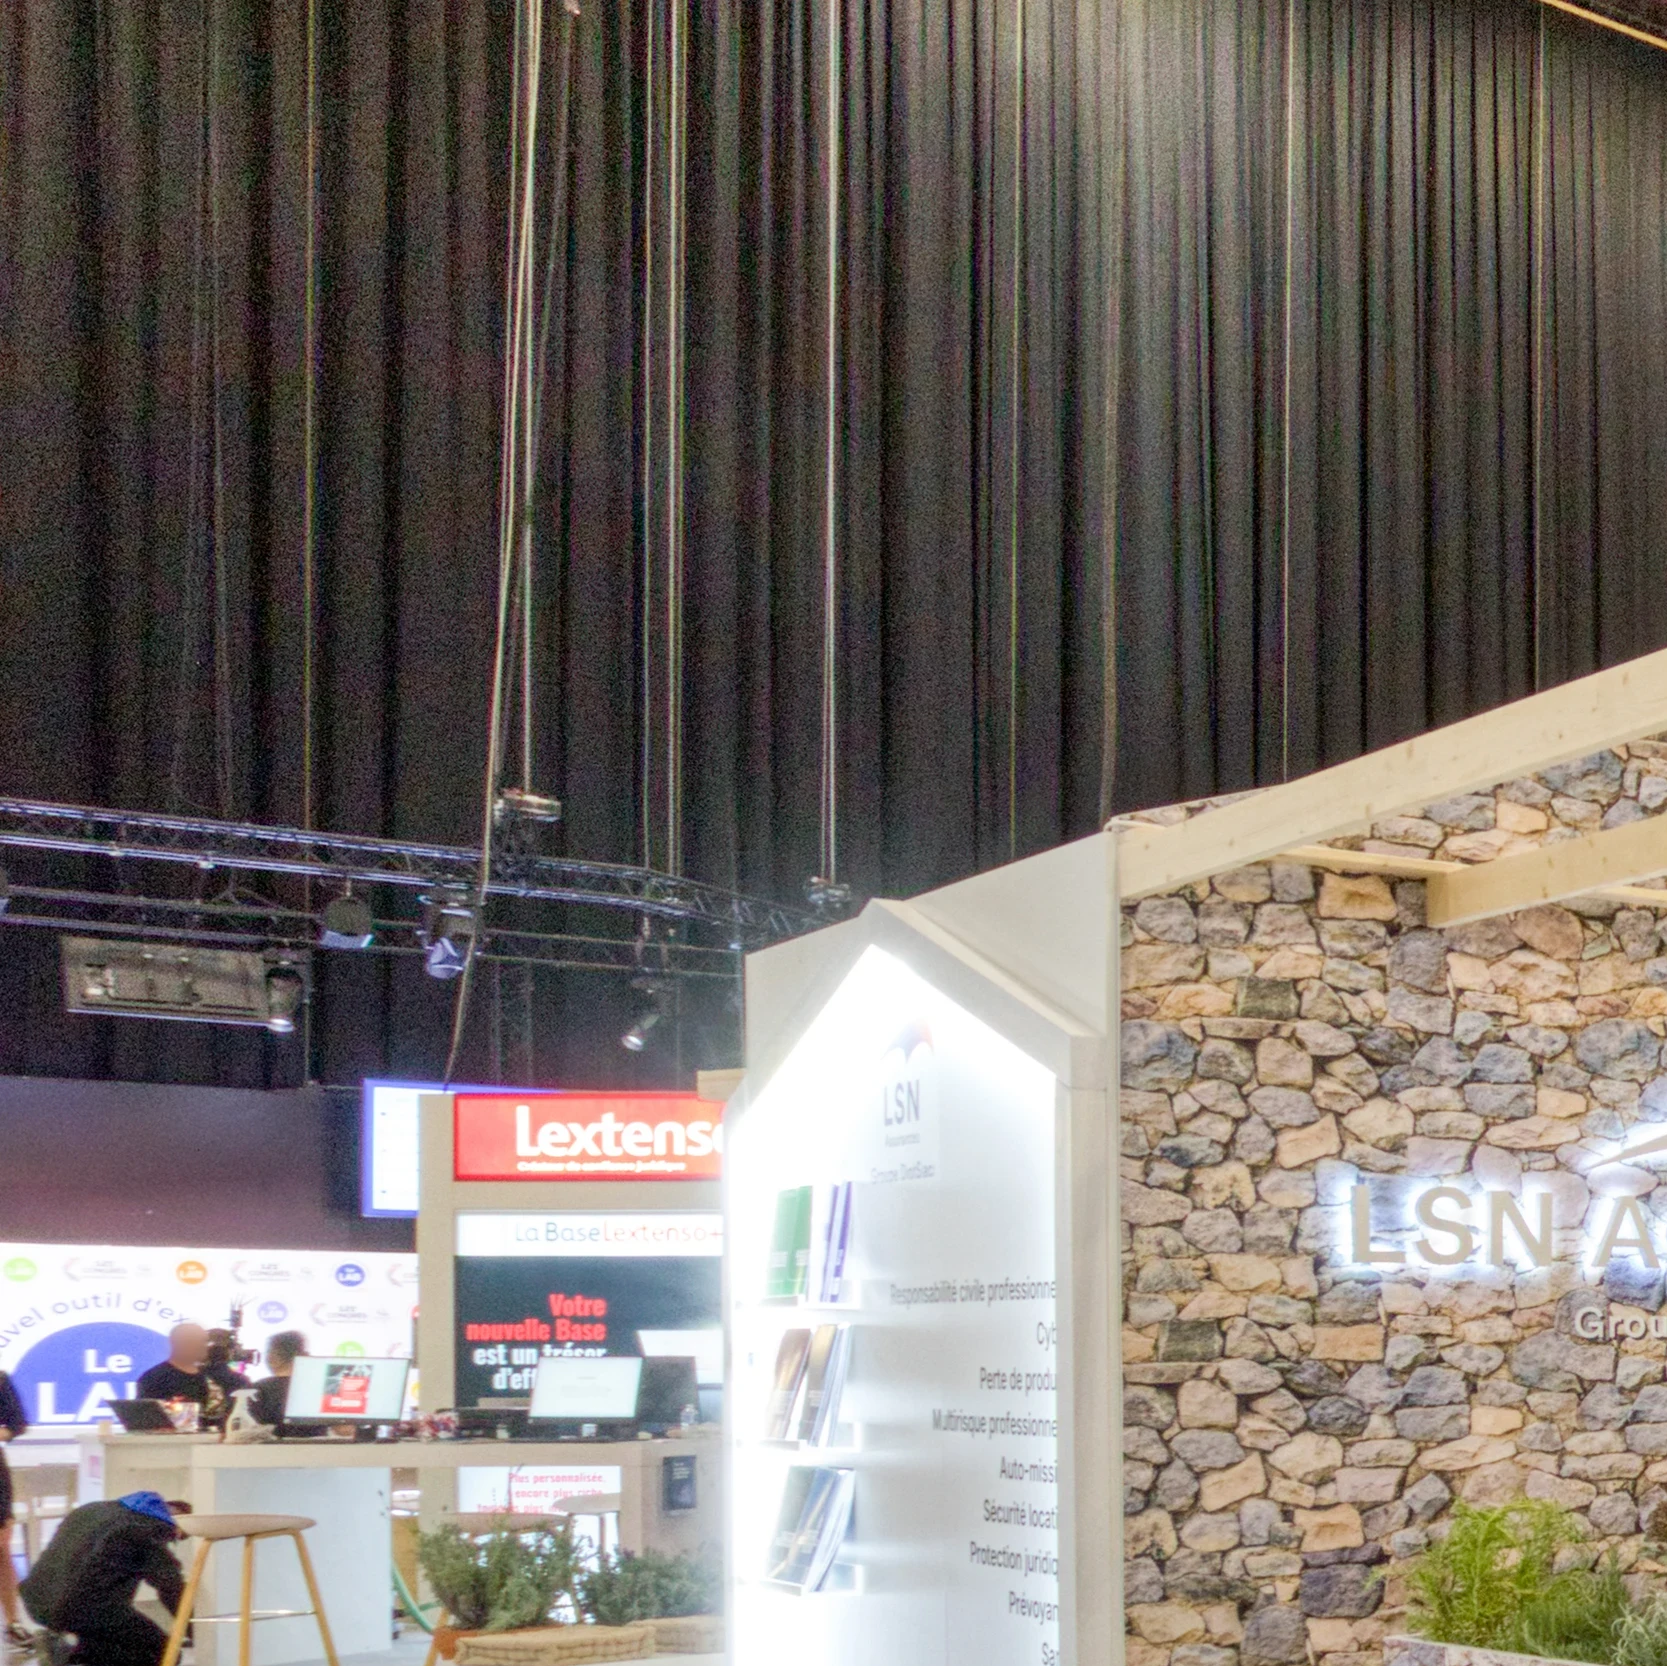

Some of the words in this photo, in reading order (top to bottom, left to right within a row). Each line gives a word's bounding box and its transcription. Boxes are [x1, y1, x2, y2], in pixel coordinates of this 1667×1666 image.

[884, 1080, 919, 1127] LSN
[1350, 1184, 1553, 1267] LSN
[52, 1293, 121, 1314] outil
[548, 1293, 607, 1317] Votre
[465, 1318, 551, 1341] nouvelle
[555, 1319, 607, 1341] Base
[84, 1348, 132, 1373] Le
[473, 1344, 508, 1366] est
[511, 1347, 538, 1366] un
[980, 1366, 1007, 1391] Perte
[1009, 1367, 1023, 1391] de
[37, 1381, 139, 1422] LA
[515, 1488, 549, 1498] encore
[983, 1498, 1026, 1526] Sécurité
[970, 1540, 1022, 1570] Protection
